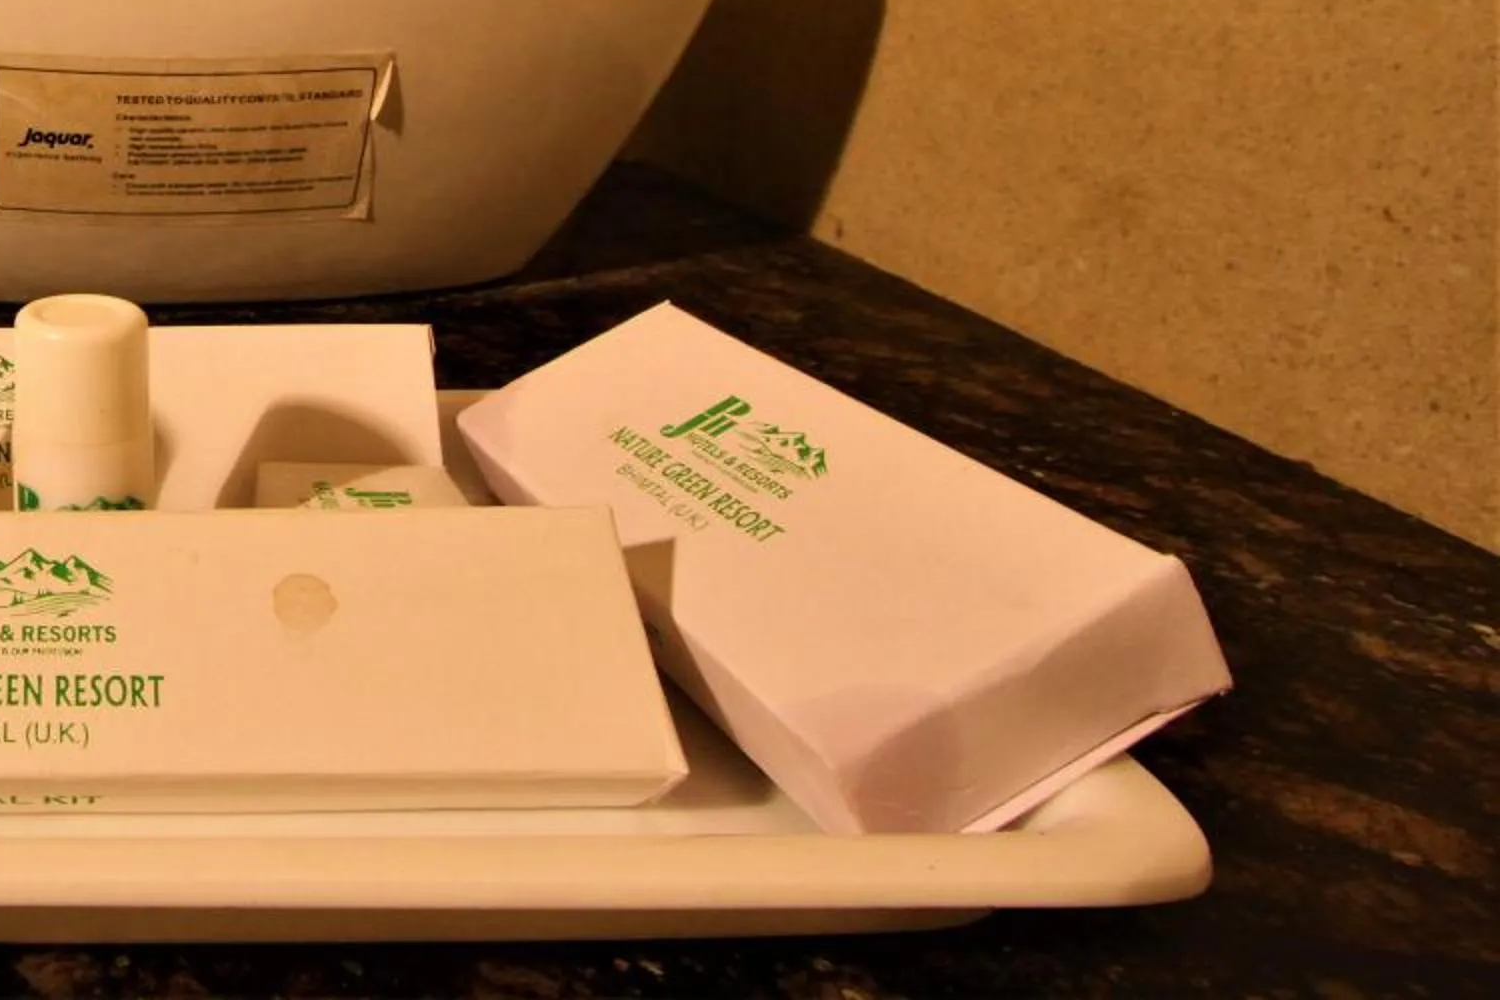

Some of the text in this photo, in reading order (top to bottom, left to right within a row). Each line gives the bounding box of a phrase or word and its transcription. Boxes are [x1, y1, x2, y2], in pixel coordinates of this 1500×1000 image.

[608, 426, 672, 469] NATURE
[661, 462, 721, 501] GREEN
[707, 492, 786, 542] RESORT
[0, 624, 14, 642] &
[21, 624, 117, 643] RESORTS
[55, 674, 165, 708] RESORT
[24, 721, 90, 749] (U.K.)
[43, 794, 104, 806] KIT
